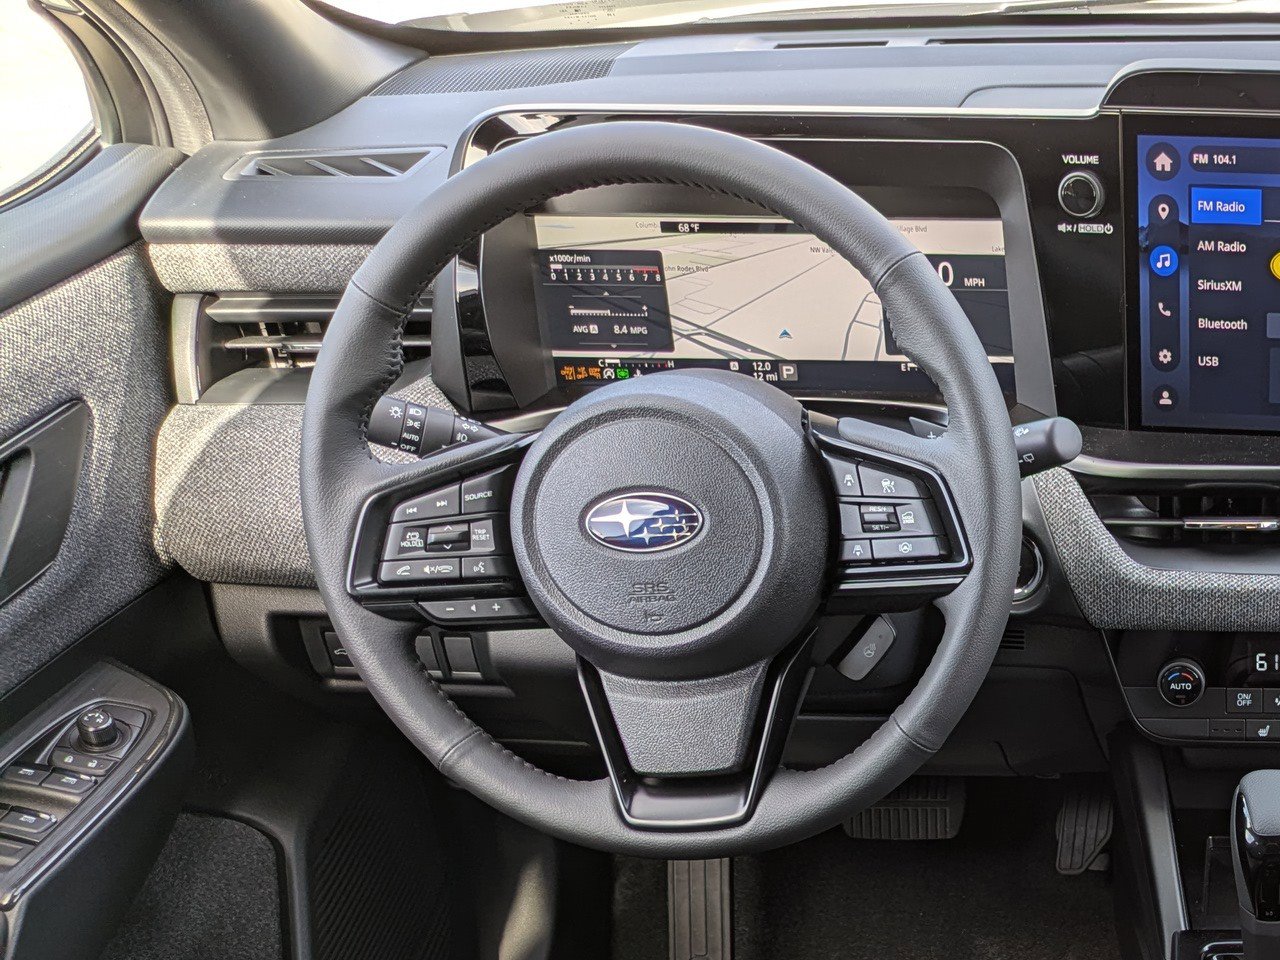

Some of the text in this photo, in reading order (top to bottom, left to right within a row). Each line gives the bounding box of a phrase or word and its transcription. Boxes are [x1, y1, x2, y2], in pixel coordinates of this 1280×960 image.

[1062, 155, 1099, 165] VOLUME
[1193, 154, 1237, 165] FM 104.1
[1198, 201, 1245, 213] FM Radio
[915, 225, 928, 233] Blvd
[1197, 242, 1246, 252] AM Radio
[549, 254, 591, 264] x1000r/min
[590, 273, 596, 281] 3
[602, 273, 608, 281] 4
[616, 273, 621, 281] 5
[938, 261, 985, 287] 0 MPH
[1198, 280, 1242, 292] SiriusXM
[1198, 318, 1247, 330] Bluetooth
[573, 325, 648, 335] AVG 8.4 MPG
[598, 360, 605, 368] C
[668, 360, 675, 368] H
[752, 362, 771, 371] 12.0
[1198, 356, 1219, 367] USB
[753, 372, 778, 381] 12 mi
[782, 366, 794, 379] P
[402, 432, 419, 442] AUTO
[400, 443, 417, 452] OFF
[465, 490, 493, 501] SOURCE
[632, 583, 670, 593] SRS
[1256, 652, 1279, 672] 61
[1170, 682, 1192, 690] AUTO
[1237, 699, 1252, 707] OFF
